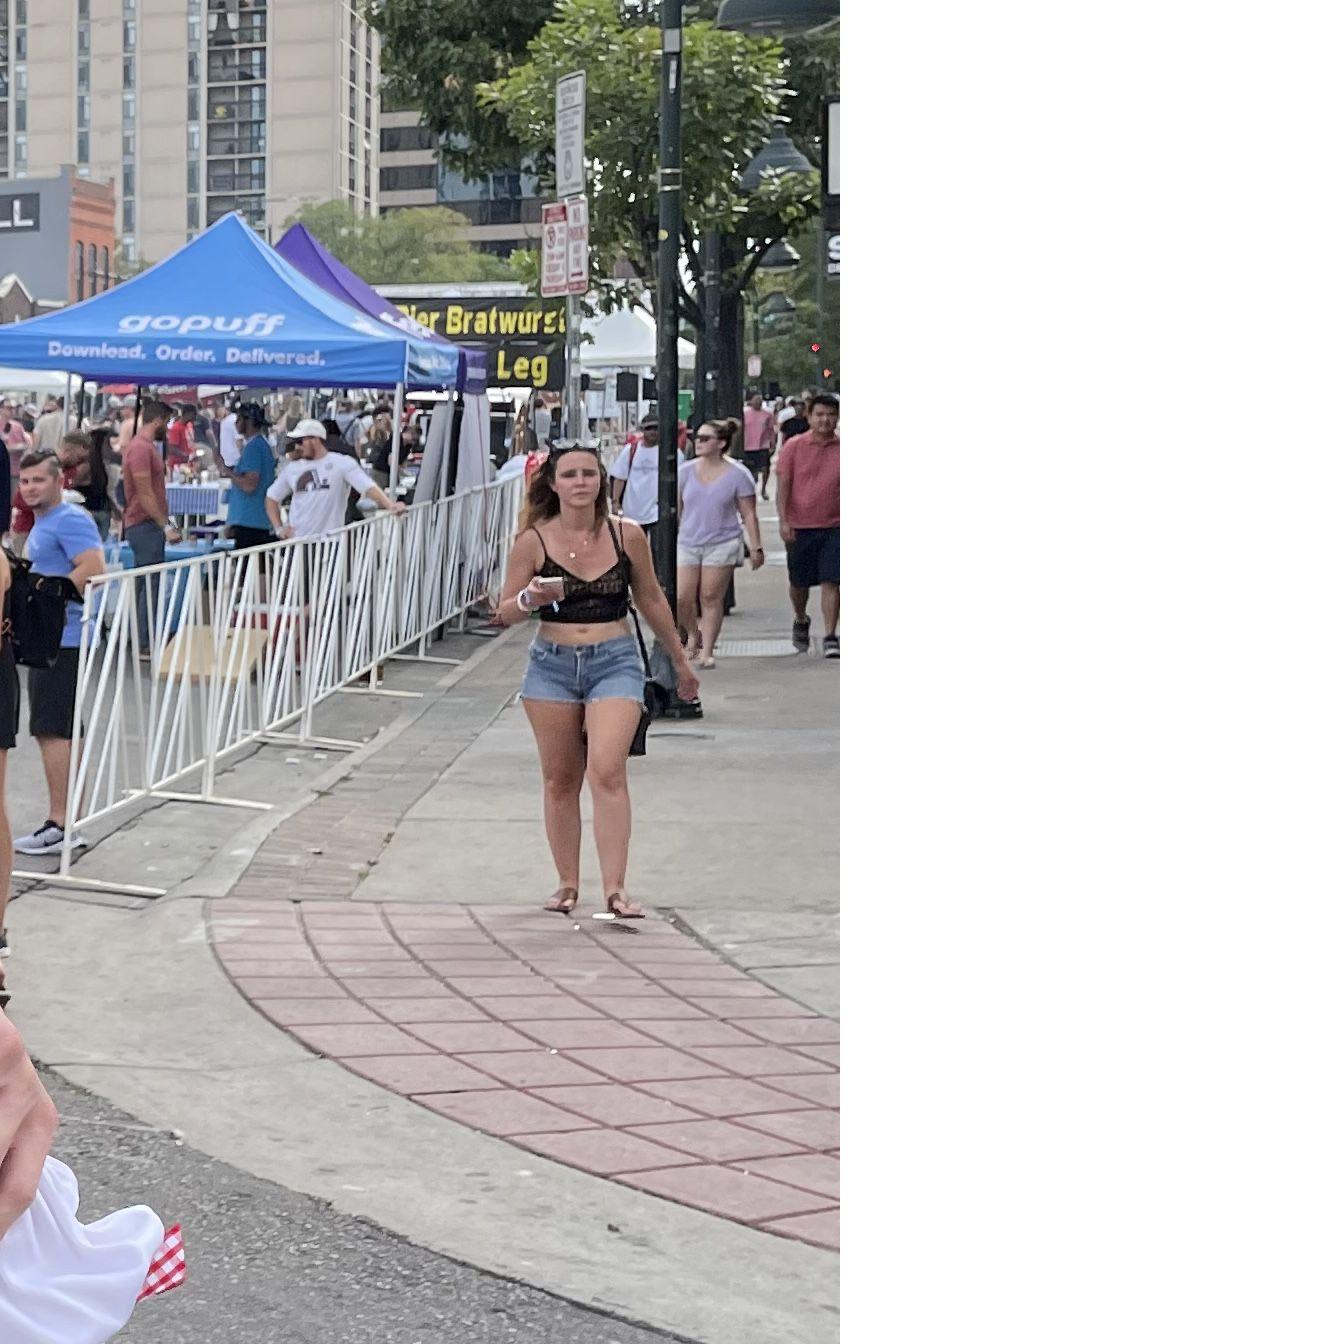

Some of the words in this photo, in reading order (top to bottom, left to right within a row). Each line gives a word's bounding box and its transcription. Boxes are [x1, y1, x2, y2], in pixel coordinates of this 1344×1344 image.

[117, 312, 286, 337] gopuff
[47, 341, 147, 360] Download.
[155, 344, 217, 363] Order.
[225, 347, 326, 367] Delivered.
[497, 350, 549, 388] Leg
